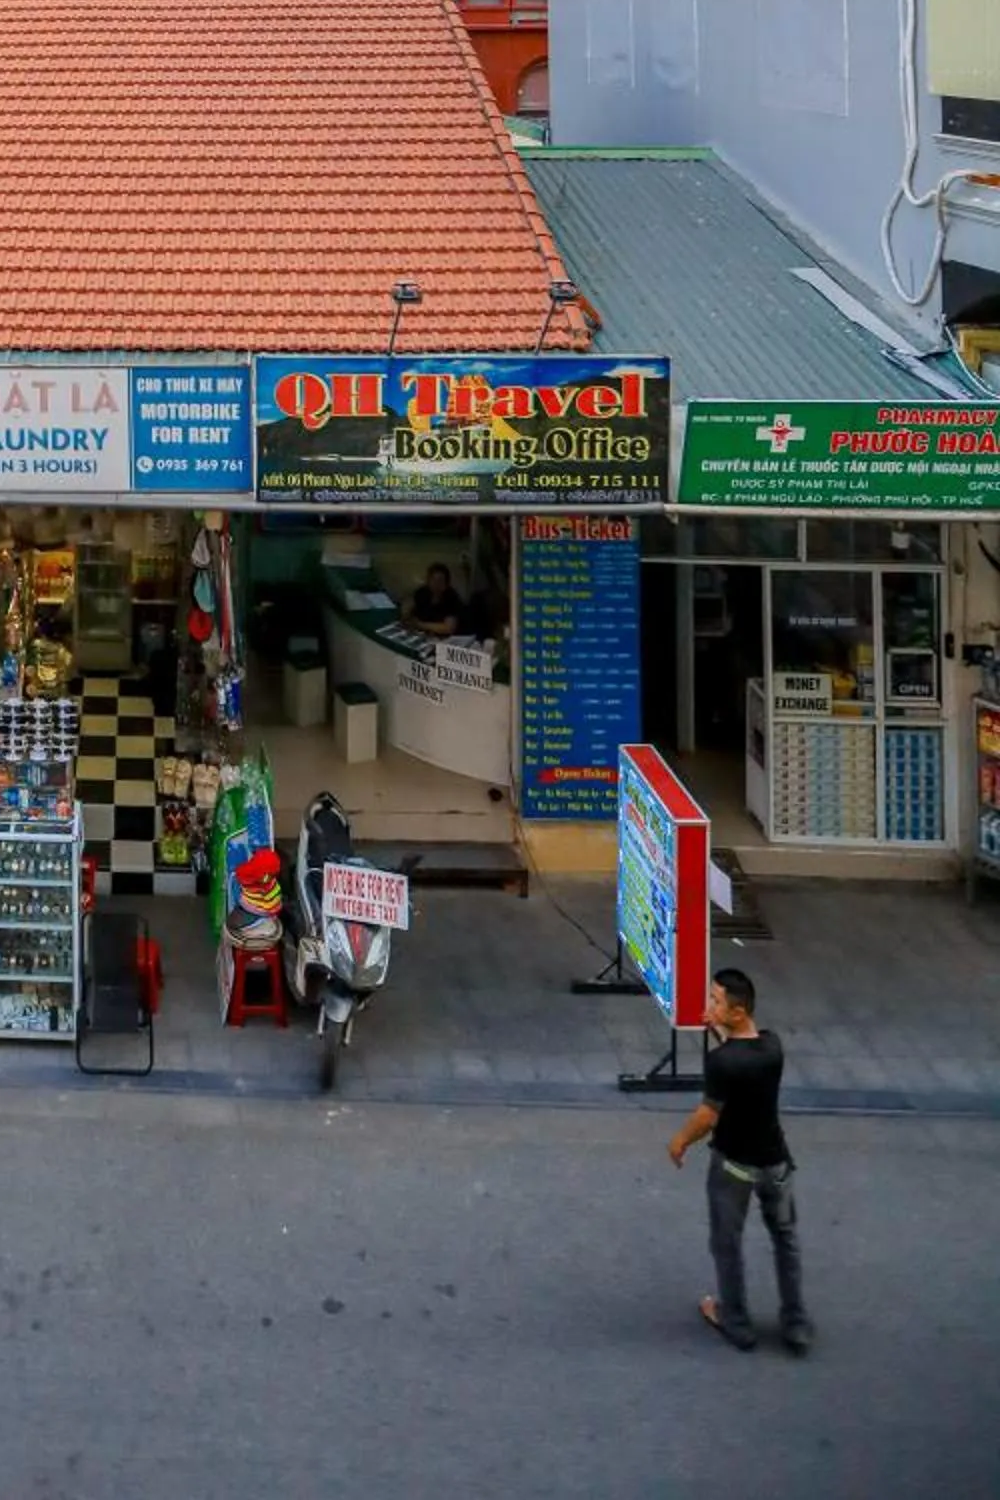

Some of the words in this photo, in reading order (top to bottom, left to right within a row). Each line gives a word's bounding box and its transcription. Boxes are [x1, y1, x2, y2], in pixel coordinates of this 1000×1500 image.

[71, 372, 120, 414] LÀ
[137, 377, 161, 393] CHO
[274, 372, 387, 430] QH
[402, 372, 649, 419] Travel
[141, 403, 241, 420] MOTORBIKE
[876, 407, 998, 426] PHARMACY
[152, 426, 182, 443] FOR
[189, 426, 231, 443] RENT
[830, 427, 929, 455] PHƯỚC
[937, 428, 1000, 455] HOÀ
[394, 427, 538, 468] Booking
[544, 427, 650, 462] Office
[19, 459, 28, 474] 3
[33, 459, 98, 474] HOURS)
[222, 460, 244, 473] 761
[701, 457, 751, 473] CHUYÊN
[589, 475, 623, 487] 715
[630, 475, 660, 487] 111
[447, 647, 482, 668] MONEY
[438, 665, 493, 690] EXCHANGE
[785, 677, 821, 690] MONEY
[898, 684, 930, 694] OPEN
[775, 695, 829, 710] EXCHANGE
[367, 873, 382, 901] FOR
[385, 877, 405, 905] RENT
